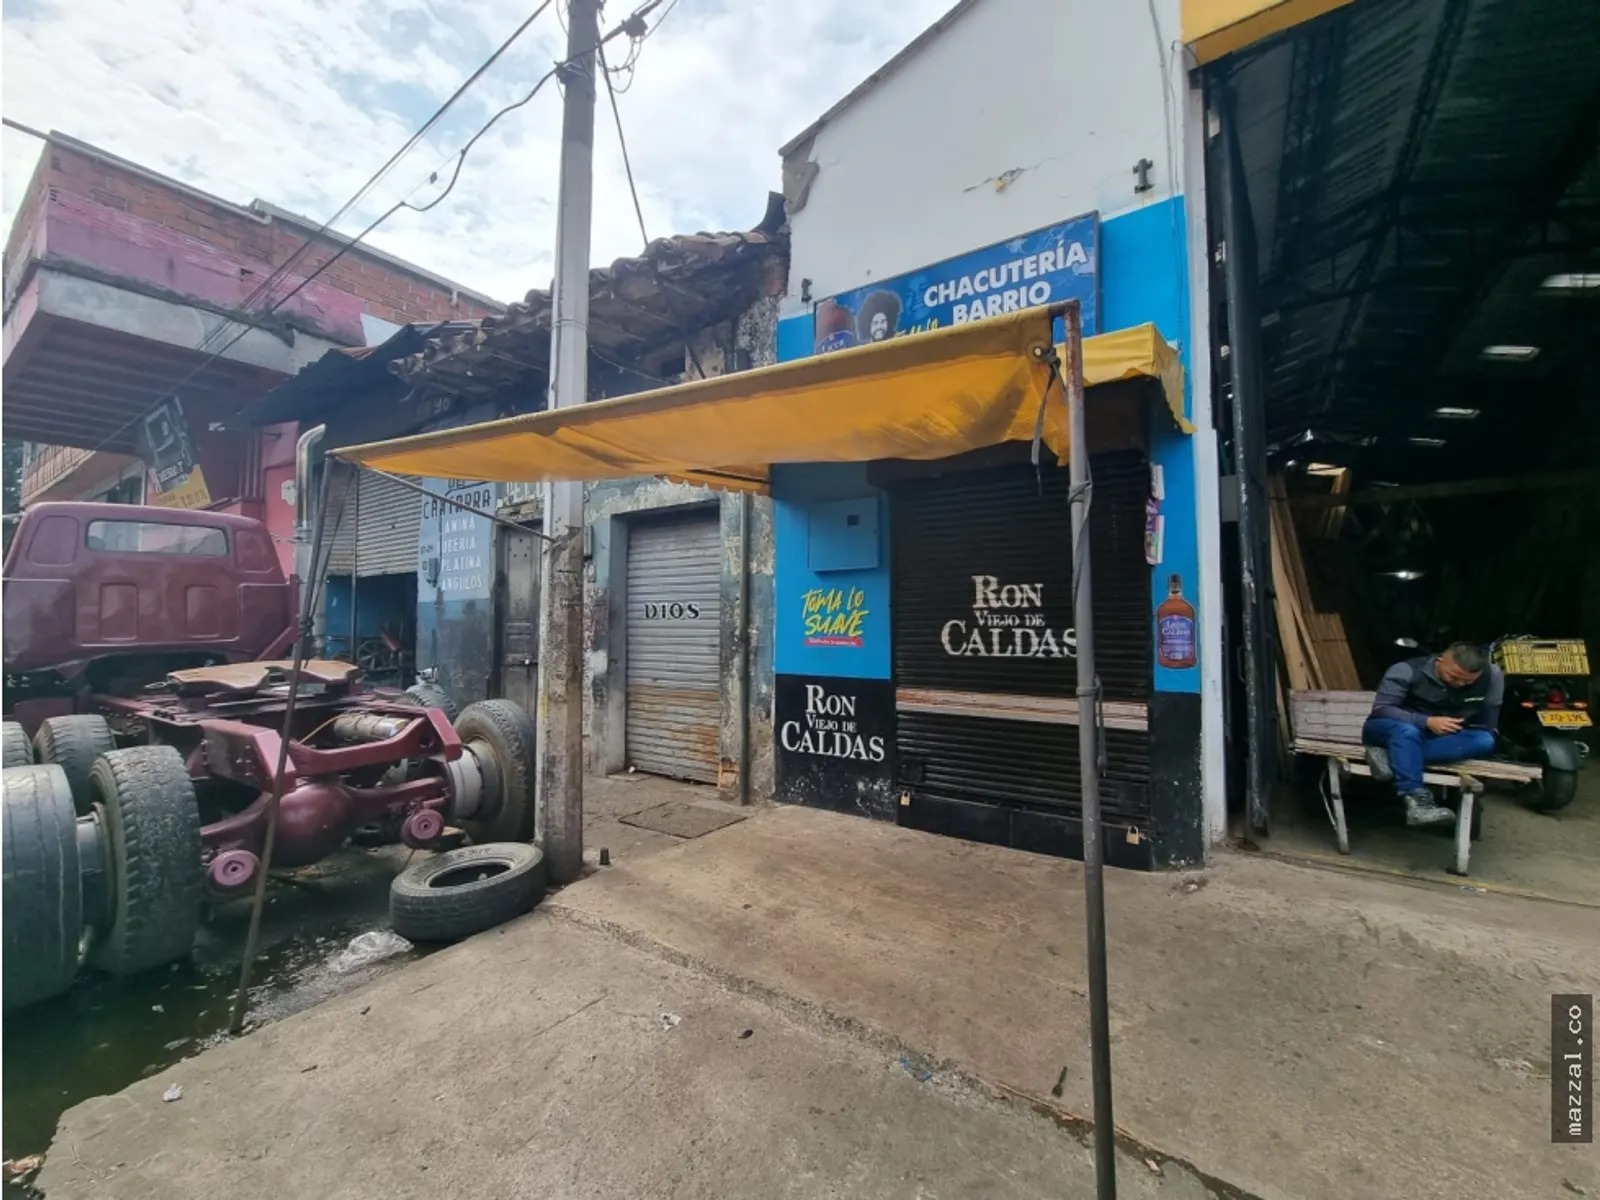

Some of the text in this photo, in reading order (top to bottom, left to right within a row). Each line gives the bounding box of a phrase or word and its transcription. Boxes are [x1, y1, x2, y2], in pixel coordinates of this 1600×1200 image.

[923, 241, 1088, 308] CHACUTERÍA
[952, 281, 1052, 327] BARRIO
[644, 602, 699, 619] DIOS
[804, 610, 870, 637] SUAVE
[941, 620, 1078, 658] CALDAS
[781, 720, 884, 762] CALDAS
